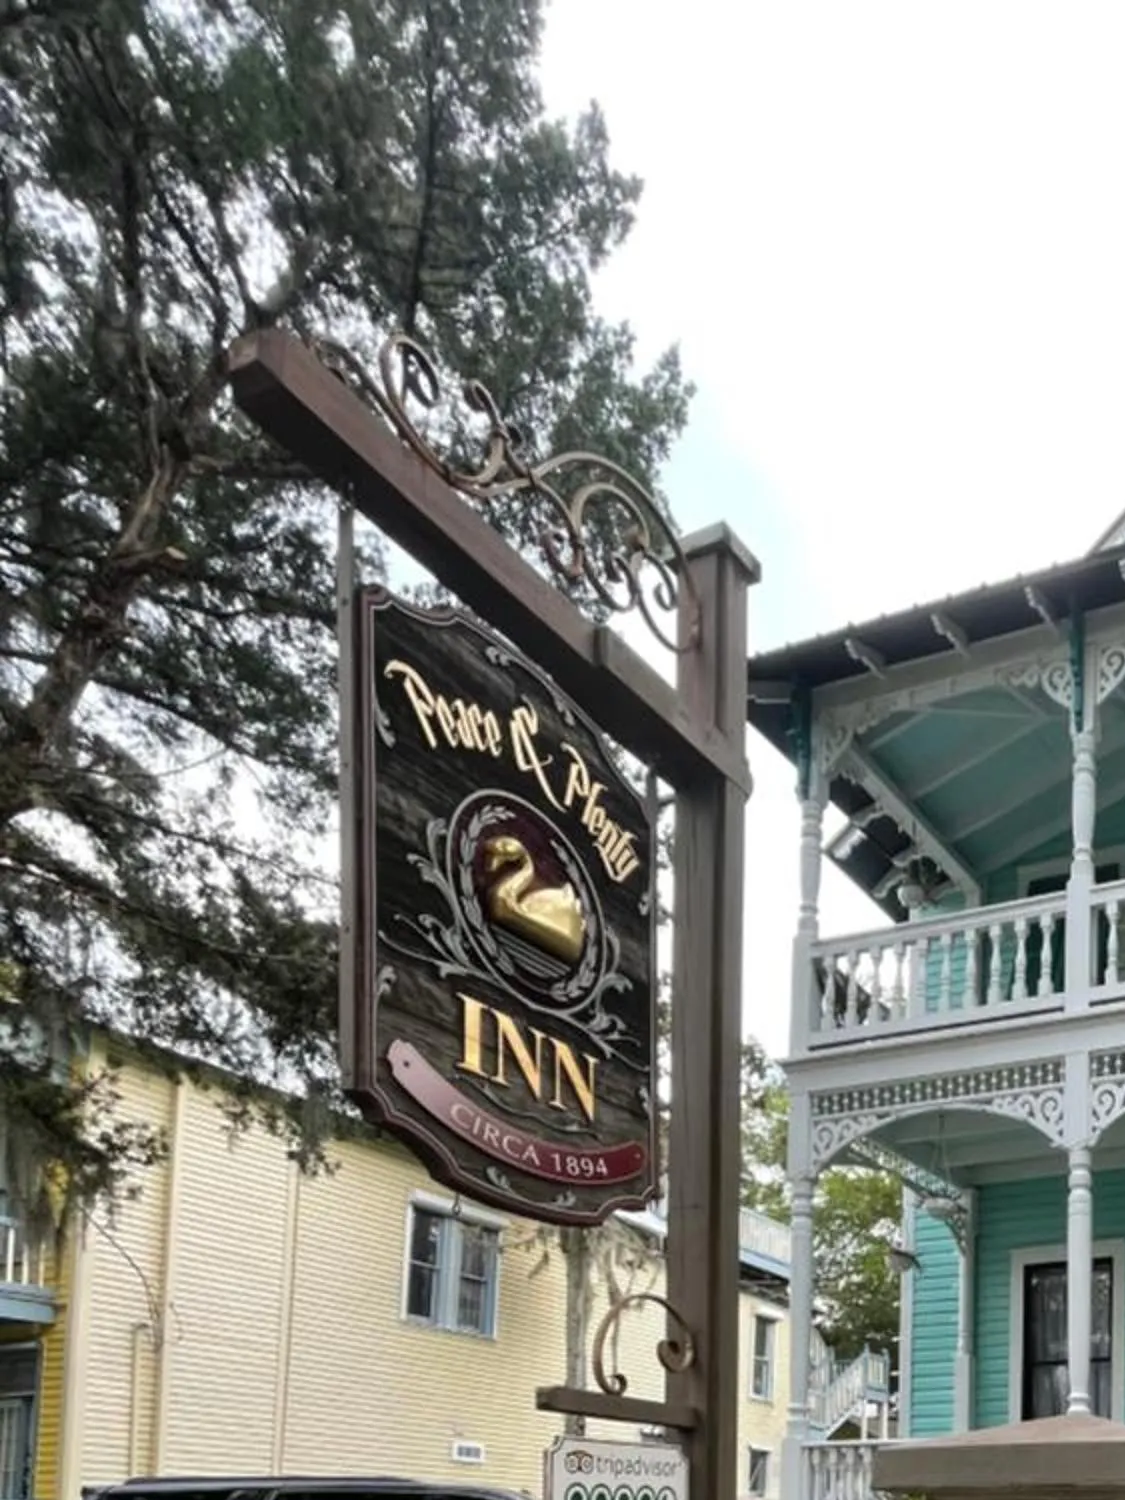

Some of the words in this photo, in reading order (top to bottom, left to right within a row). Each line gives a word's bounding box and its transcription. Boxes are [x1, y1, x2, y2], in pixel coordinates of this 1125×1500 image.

[384, 658, 502, 757] Peace
[509, 694, 567, 812] &
[559, 741, 641, 882] Plenty
[455, 991, 600, 1124] INN
[450, 1102, 541, 1167] CIRCA
[551, 1152, 608, 1177] 1894
[596, 1454, 677, 1478] tripadvisor
